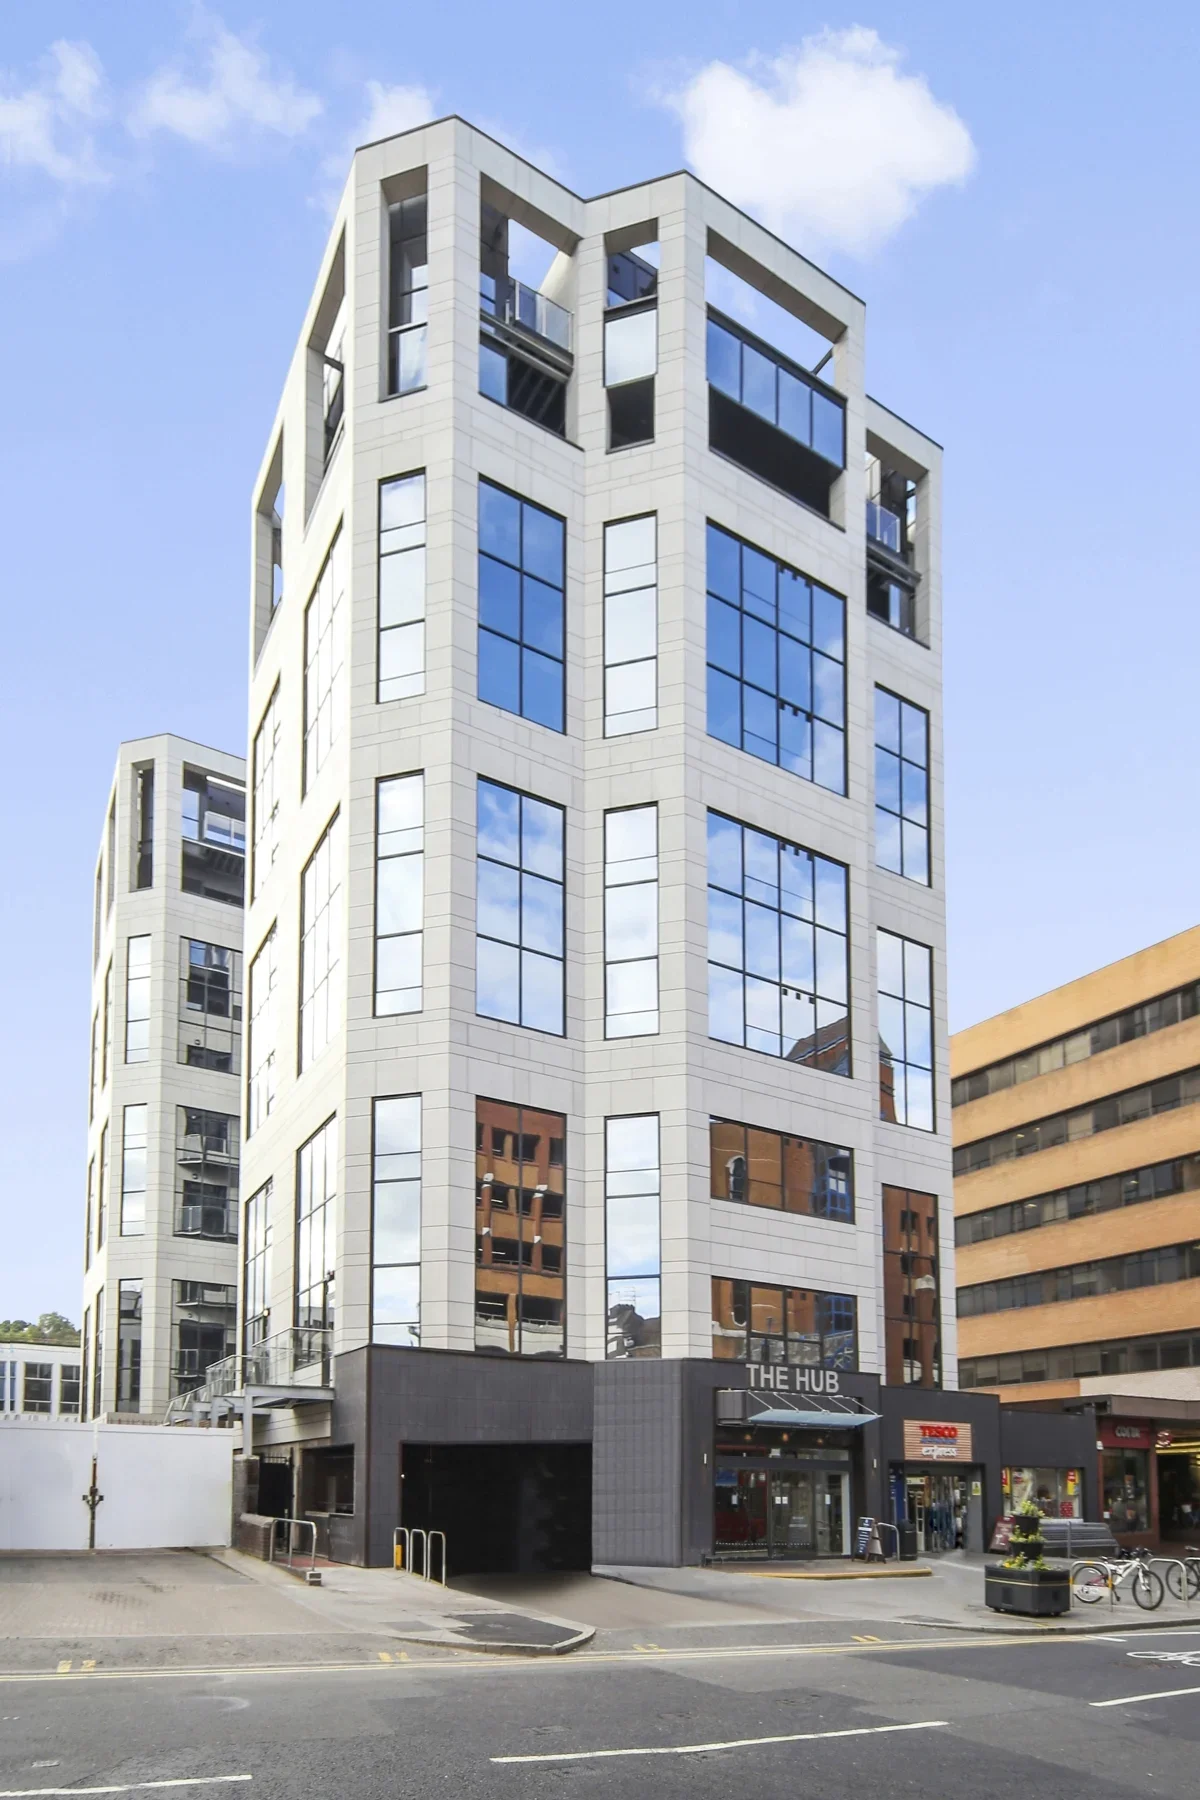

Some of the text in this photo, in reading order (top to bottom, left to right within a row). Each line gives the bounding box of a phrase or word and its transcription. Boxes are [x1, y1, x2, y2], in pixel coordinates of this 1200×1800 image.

[745, 1363, 839, 1393] THE HUB
[920, 1425, 958, 1438] TESCO
